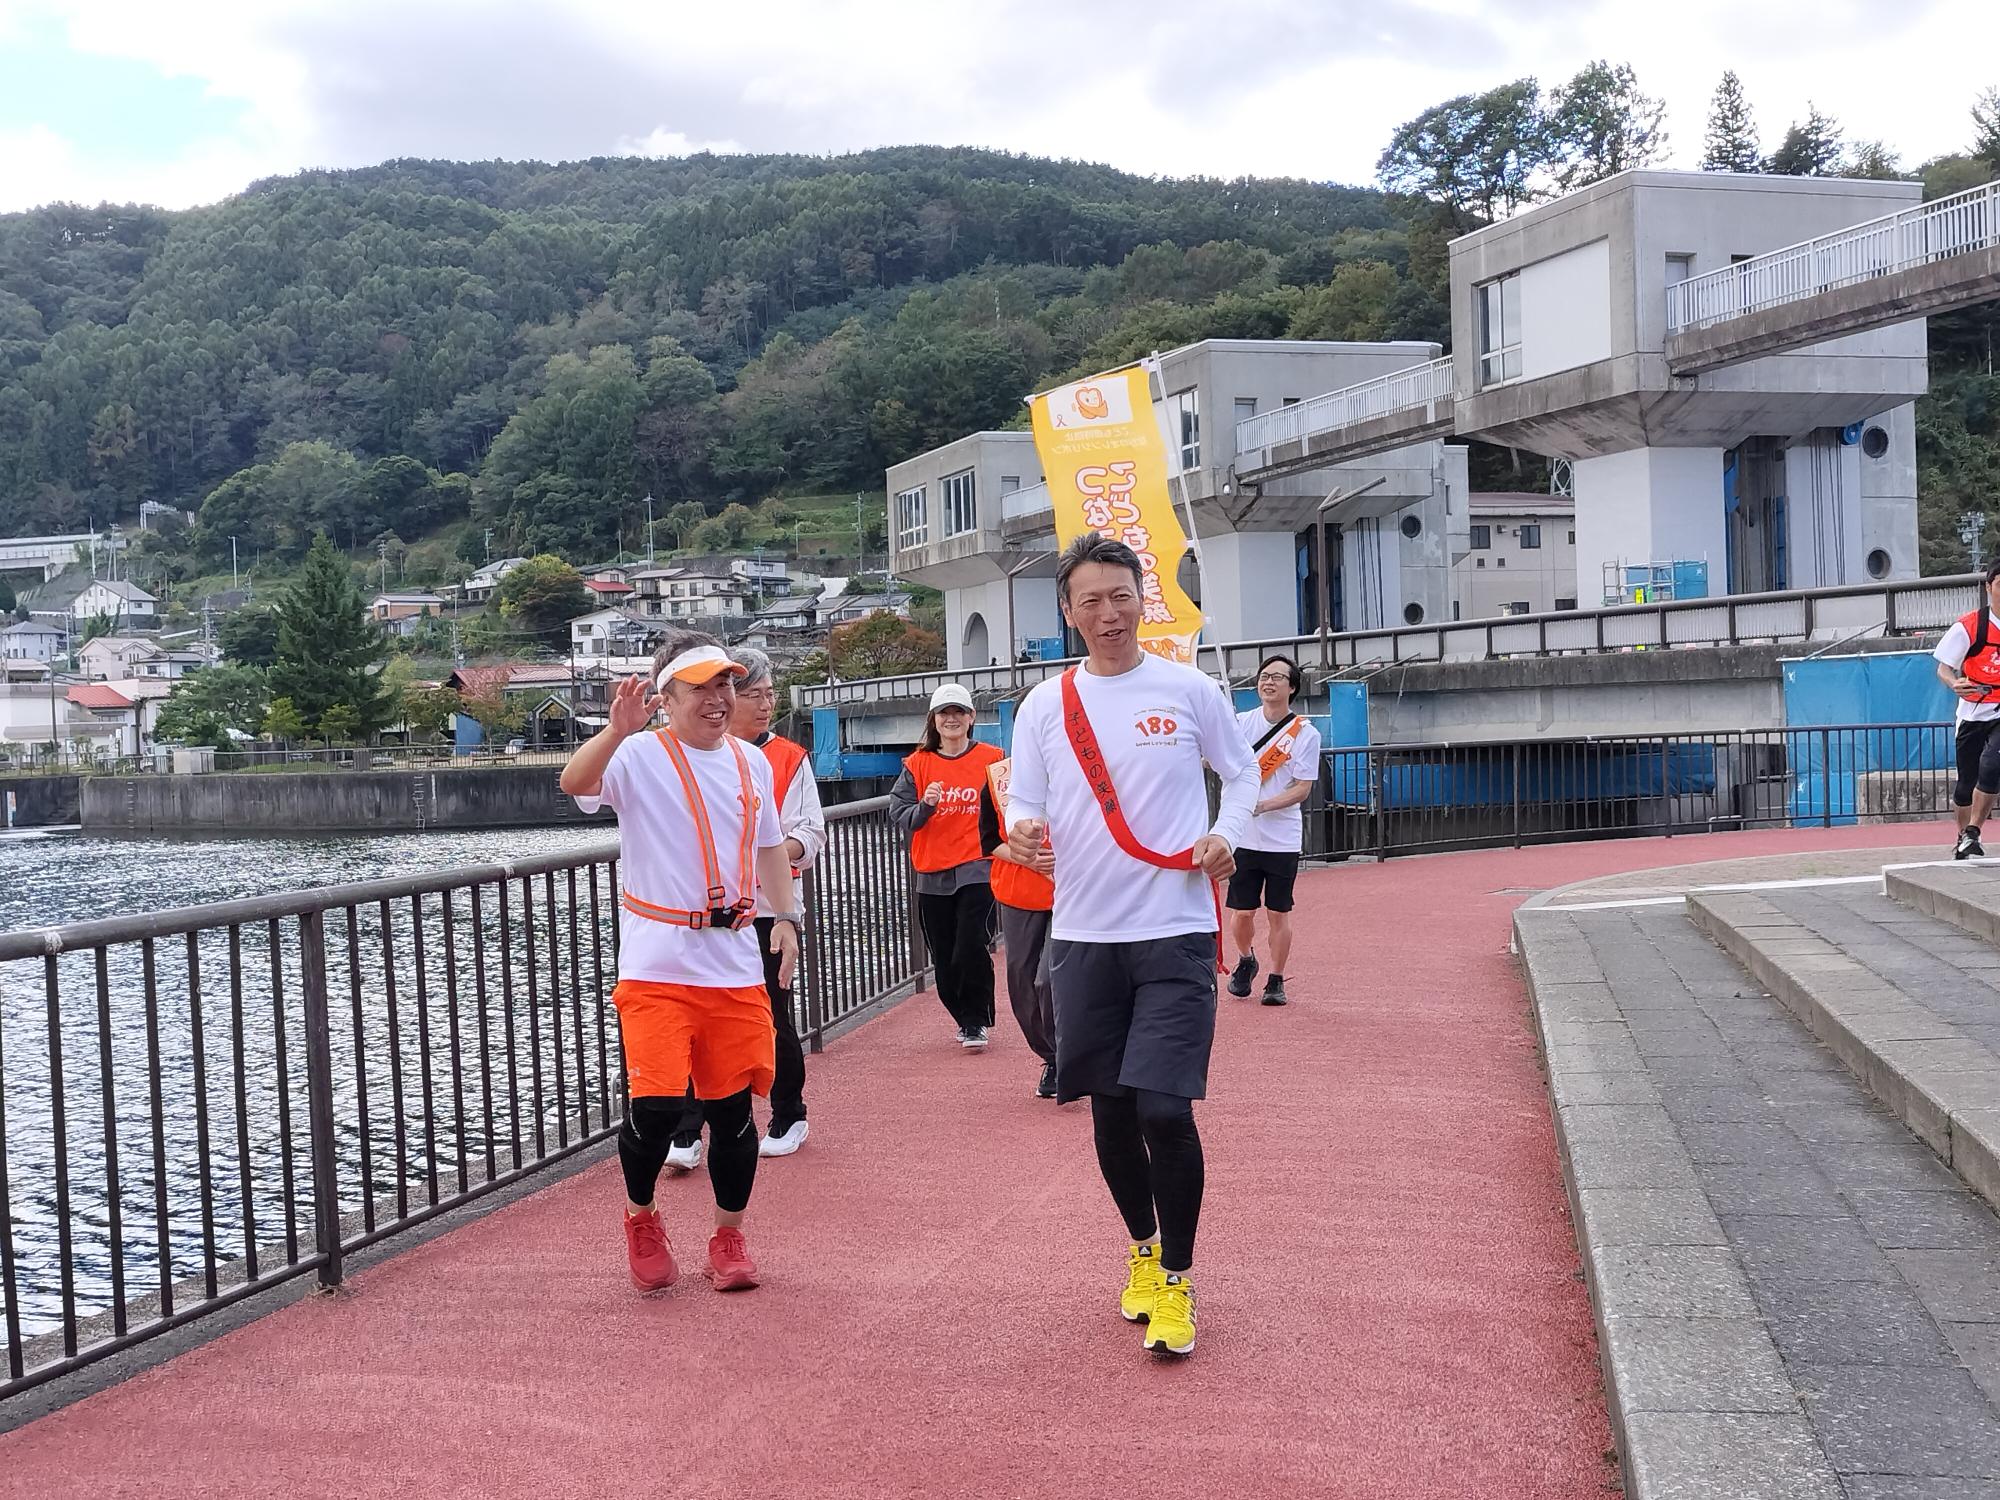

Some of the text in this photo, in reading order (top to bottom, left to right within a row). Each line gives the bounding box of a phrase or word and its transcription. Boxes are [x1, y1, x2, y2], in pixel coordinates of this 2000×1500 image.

[1135, 716, 1177, 737] 189
[936, 804, 980, 816] ンジリボ
